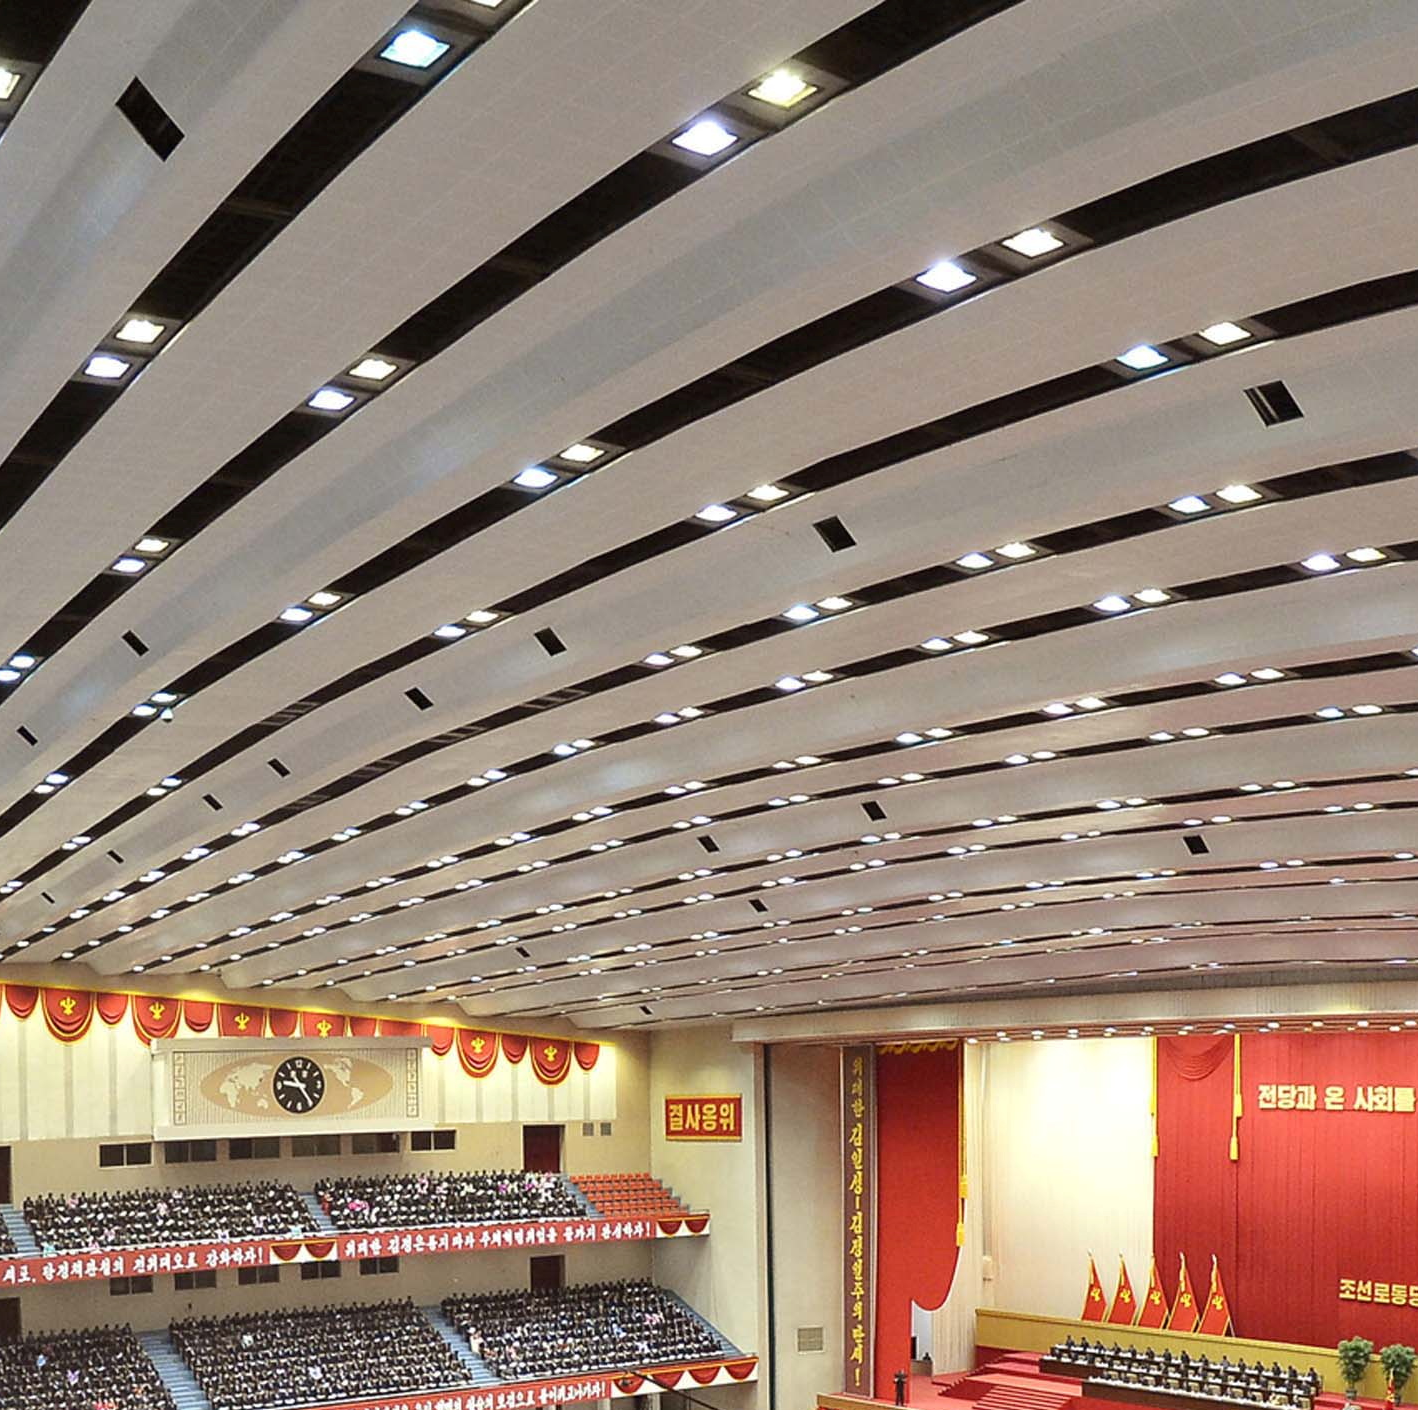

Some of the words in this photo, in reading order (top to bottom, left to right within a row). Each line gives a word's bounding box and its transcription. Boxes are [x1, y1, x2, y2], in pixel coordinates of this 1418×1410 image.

[850, 1057, 866, 1119] 위대한
[1257, 1084, 1318, 1111] 전당과
[1323, 1085, 1346, 1111] 온
[1352, 1085, 1417, 1113] 사회를
[669, 1103, 735, 1132] 결사옹위
[344, 1237, 383, 1258] 위대한
[562, 1223, 596, 1242] 끝까지
[600, 1221, 650, 1240] 완성하자!
[848, 1122, 865, 1321] 김일성-김정일주의
[132, 1251, 198, 1274] 전위대오로
[205, 1246, 263, 1268] 강화하자!
[849, 1323, 866, 1387] 만세!
